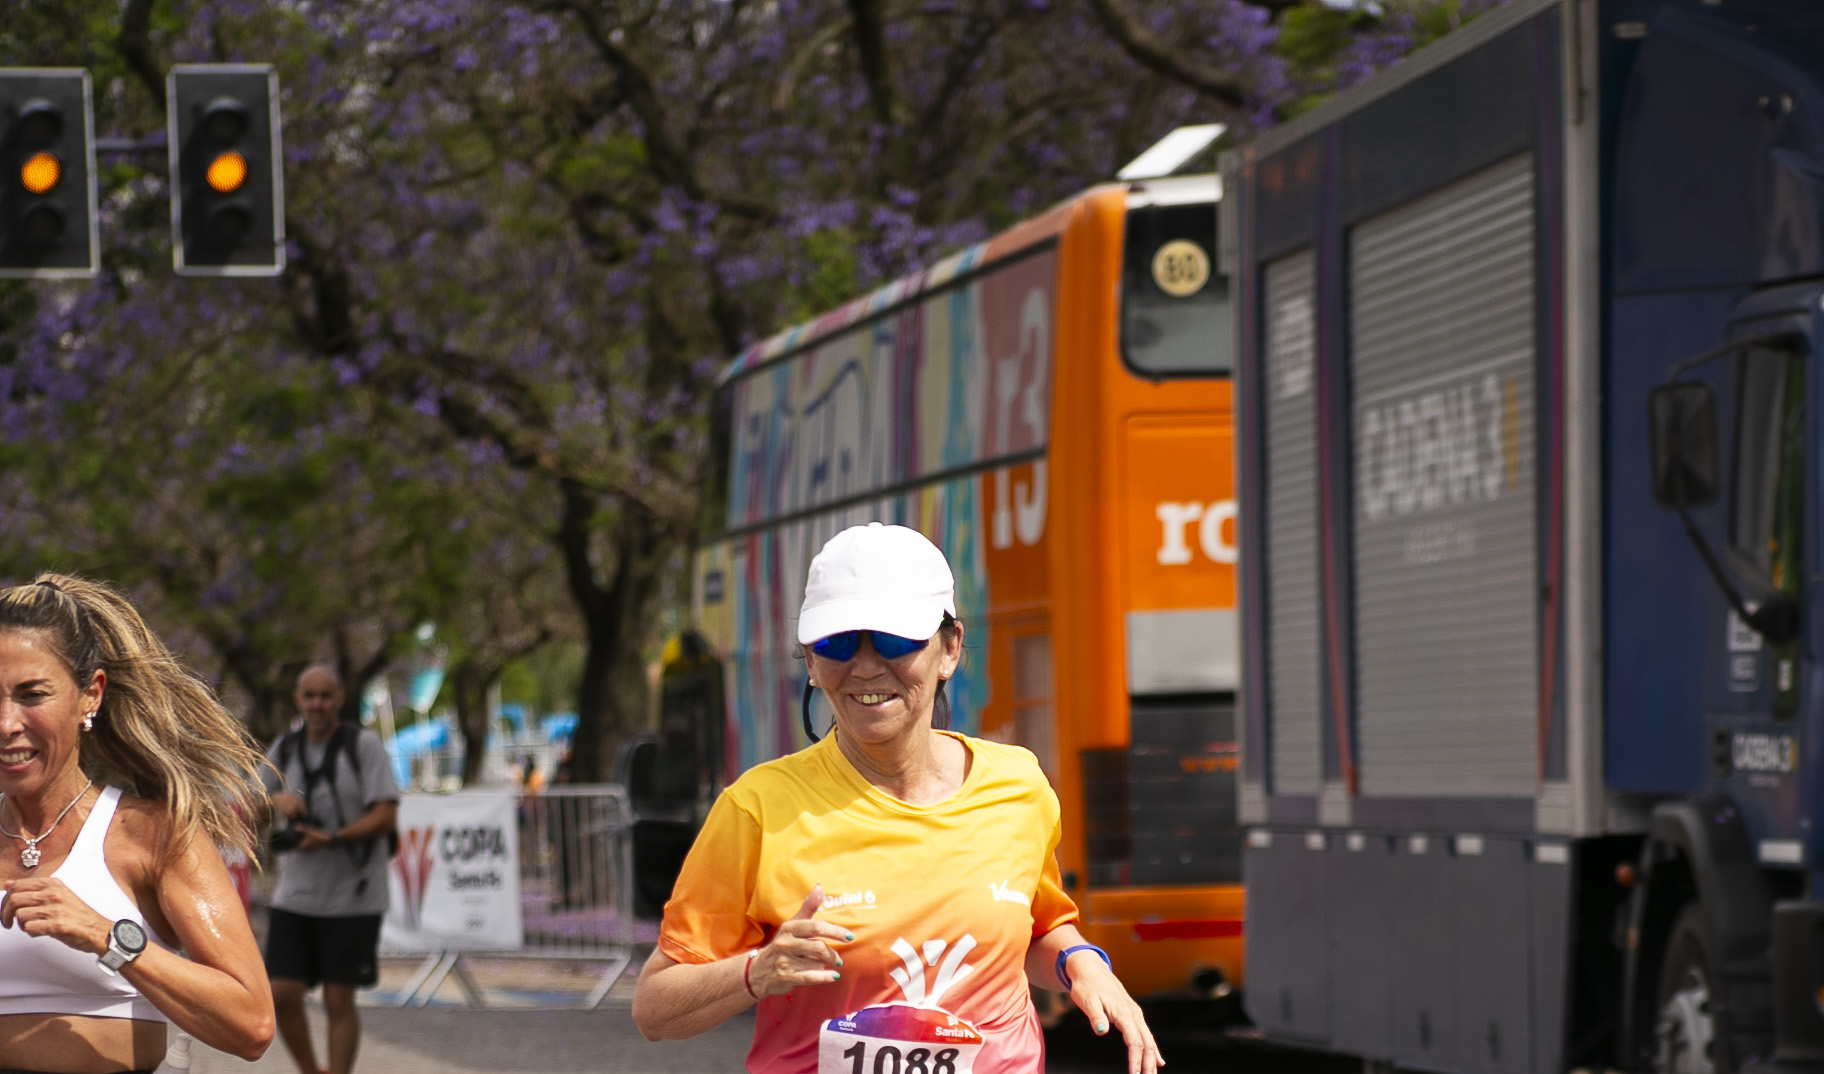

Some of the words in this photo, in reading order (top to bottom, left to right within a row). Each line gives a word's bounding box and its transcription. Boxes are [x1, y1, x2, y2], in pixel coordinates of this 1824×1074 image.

[440, 828, 506, 862] COPA
[865, 889, 876, 904] 6
[935, 1026, 964, 1038] Santa
